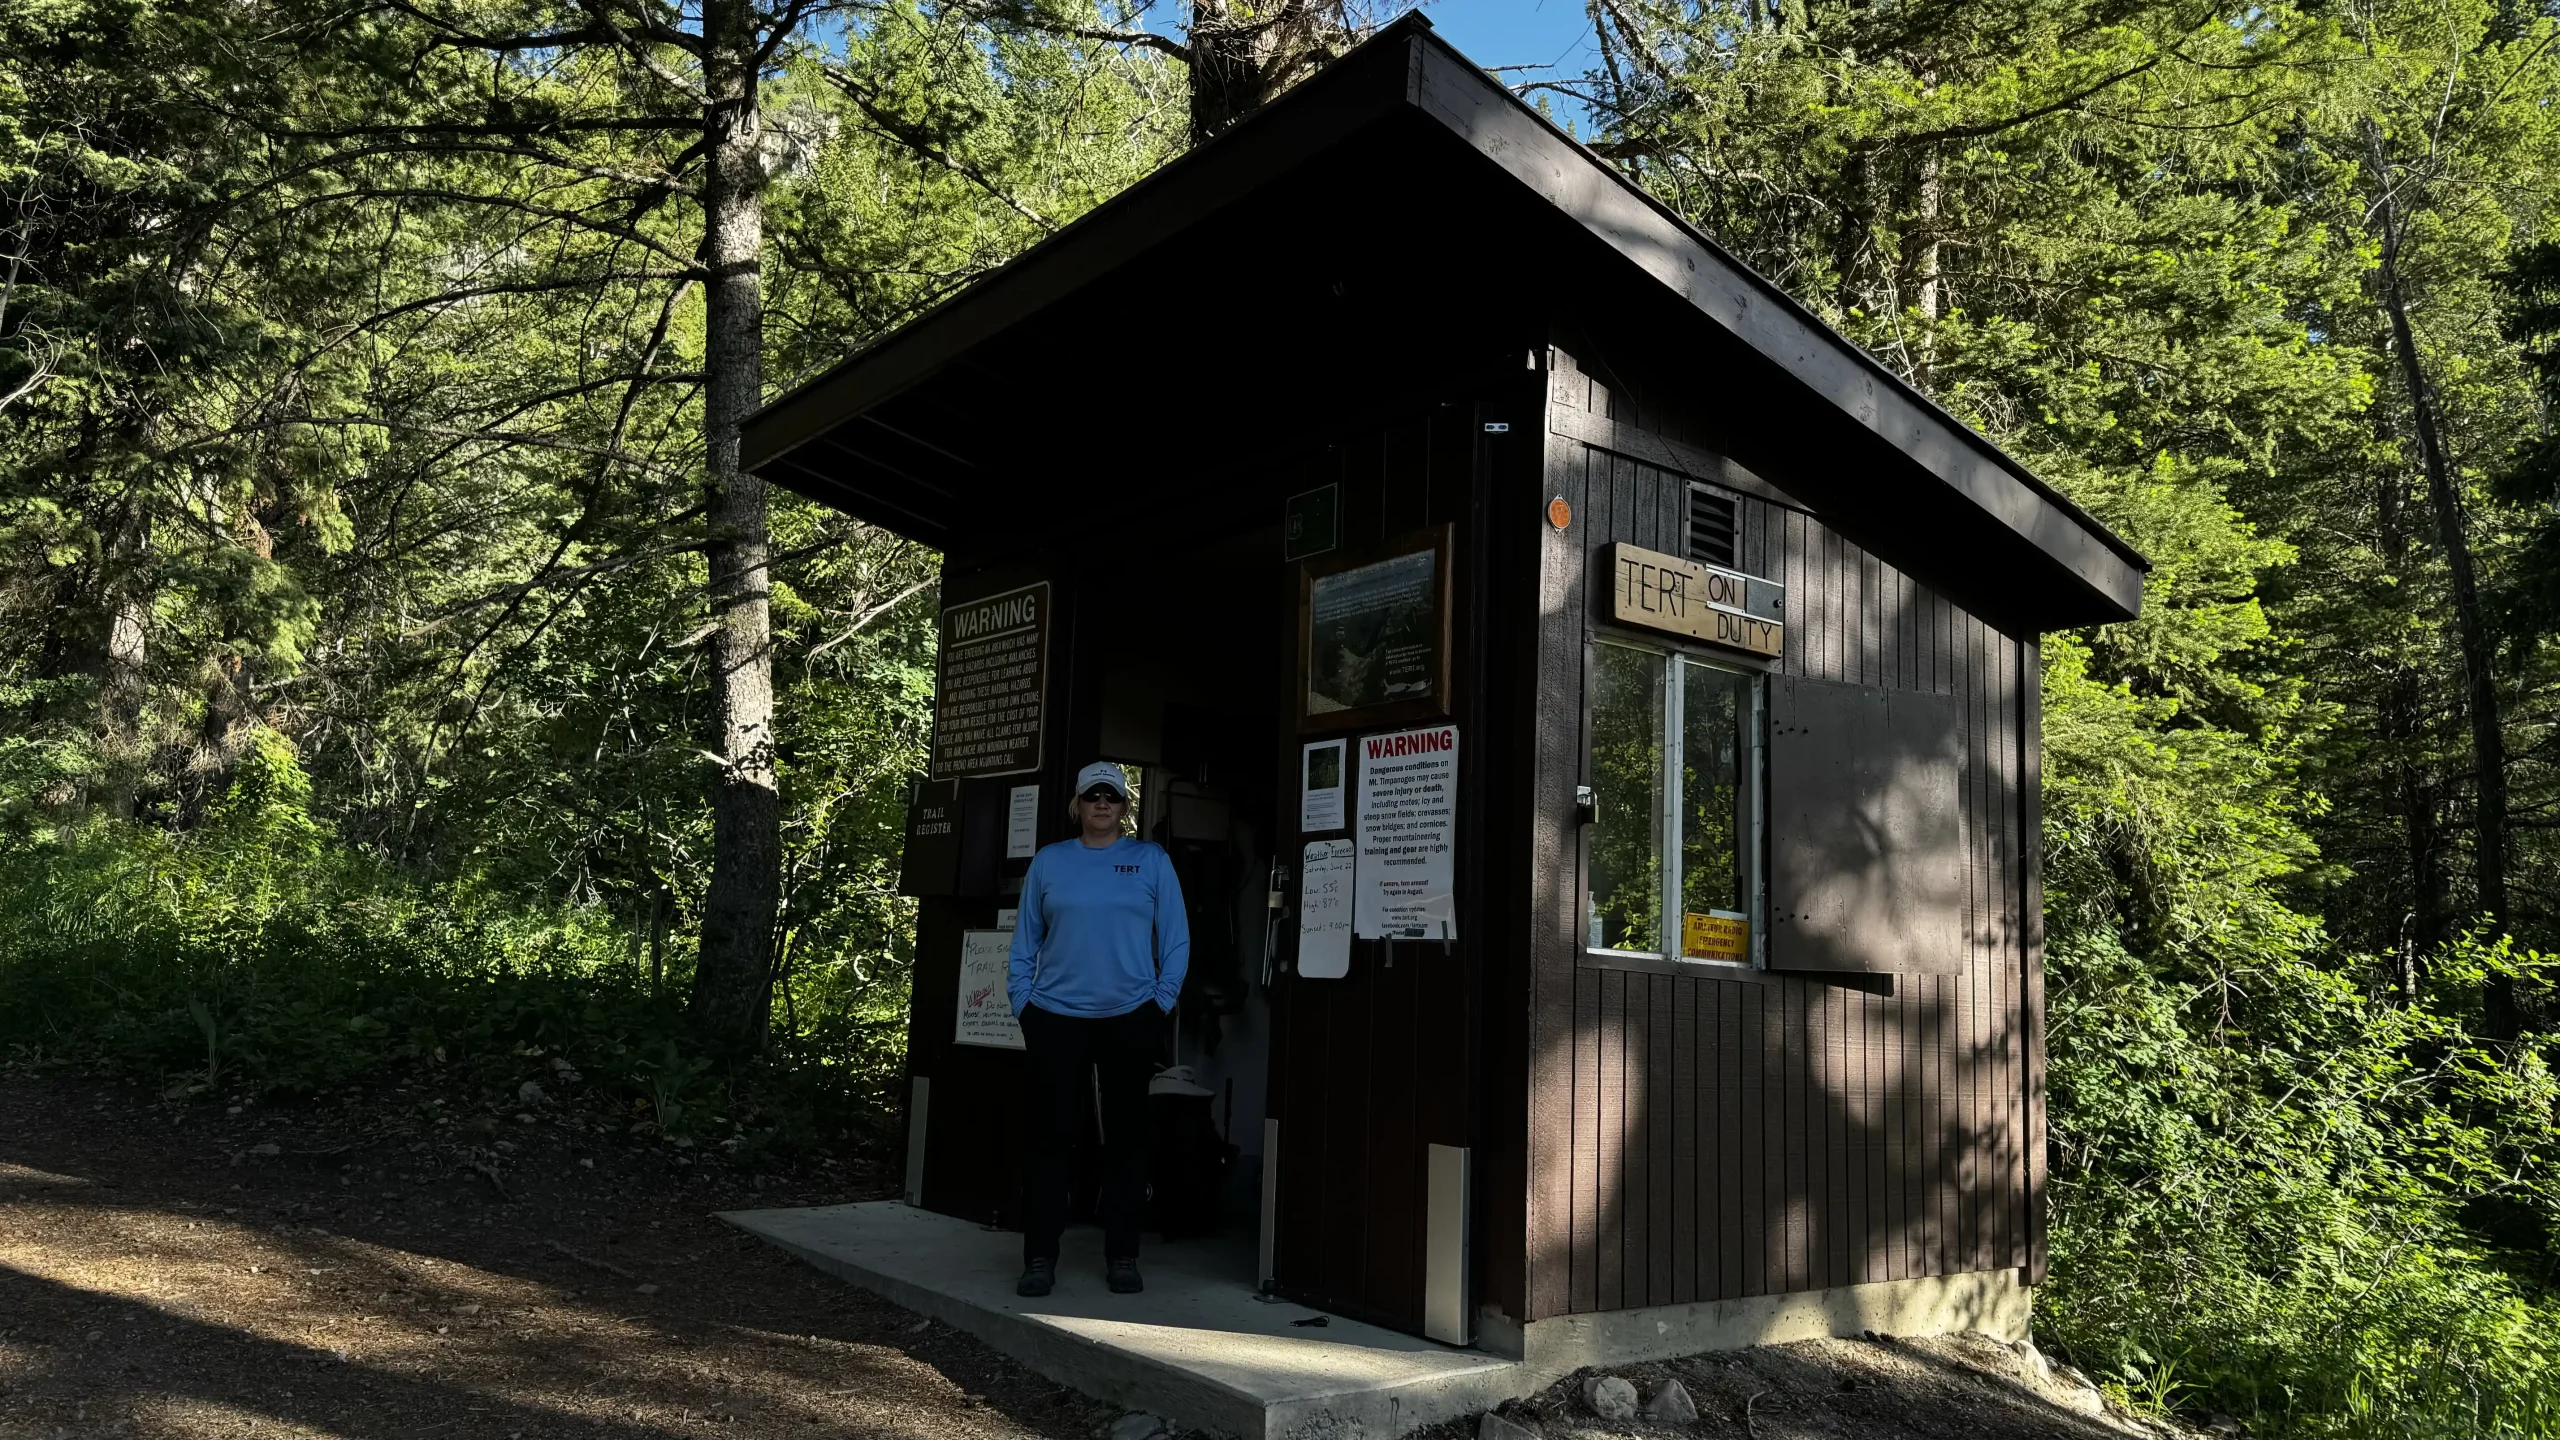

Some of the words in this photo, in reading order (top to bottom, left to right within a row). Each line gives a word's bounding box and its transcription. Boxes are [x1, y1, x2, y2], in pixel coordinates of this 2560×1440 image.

[1620, 558, 1693, 618] TERT
[1708, 574, 1735, 604] ON
[954, 594, 1036, 639] WARNING
[1718, 613, 1772, 650] DUTY
[965, 659, 985, 672] HAZARDS
[963, 672, 990, 686] RESPONSIBLE
[1001, 665, 1022, 679] LEARNING
[1022, 661, 1037, 674] ABOUT
[960, 701, 986, 714] RESPONSIBLE
[988, 699, 996, 710] FOR
[997, 697, 1009, 708] YOUR
[1010, 695, 1020, 706] OWN
[970, 715, 987, 726] RESCUE
[988, 713, 996, 724] FOR
[1007, 709, 1018, 721] COST
[1026, 705, 1038, 718] YOUR
[996, 724, 1011, 737] CLAIMS
[1012, 723, 1021, 734] FOR
[1367, 730, 1452, 759] WARNING
[1004, 753, 1014, 764] CALL
[1370, 766, 1404, 775] Dangerous
[1405, 761, 1439, 771] conditions
[1380, 776, 1415, 785] Timpanogos
[1417, 774, 1429, 782] may
[1431, 772, 1449, 780] cause
[1395, 787, 1413, 796] injury
[1423, 784, 1444, 792] death,
[1371, 800, 1398, 808] including
[1422, 797, 1430, 805] icy
[1432, 795, 1444, 804] and
[923, 806, 945, 820] TRAIL
[1364, 813, 1380, 821] steep
[916, 822, 951, 836] REGISTER
[1407, 821, 1418, 829] and
[1373, 835, 1391, 844] Proper
[1393, 832, 1440, 842] mountaineering
[1365, 847, 1388, 855] training
[1430, 844, 1448, 853] highly
[1384, 856, 1427, 866] recommended.
[1113, 865, 1140, 874] TERT
[1693, 922, 1722, 933] AMATEUR
[1724, 925, 1743, 936] RADIO
[1700, 936, 1734, 948] EMERGENCY
[1688, 948, 1743, 961] COMMUNICATIONS
[968, 960, 996, 976] TRAIL
